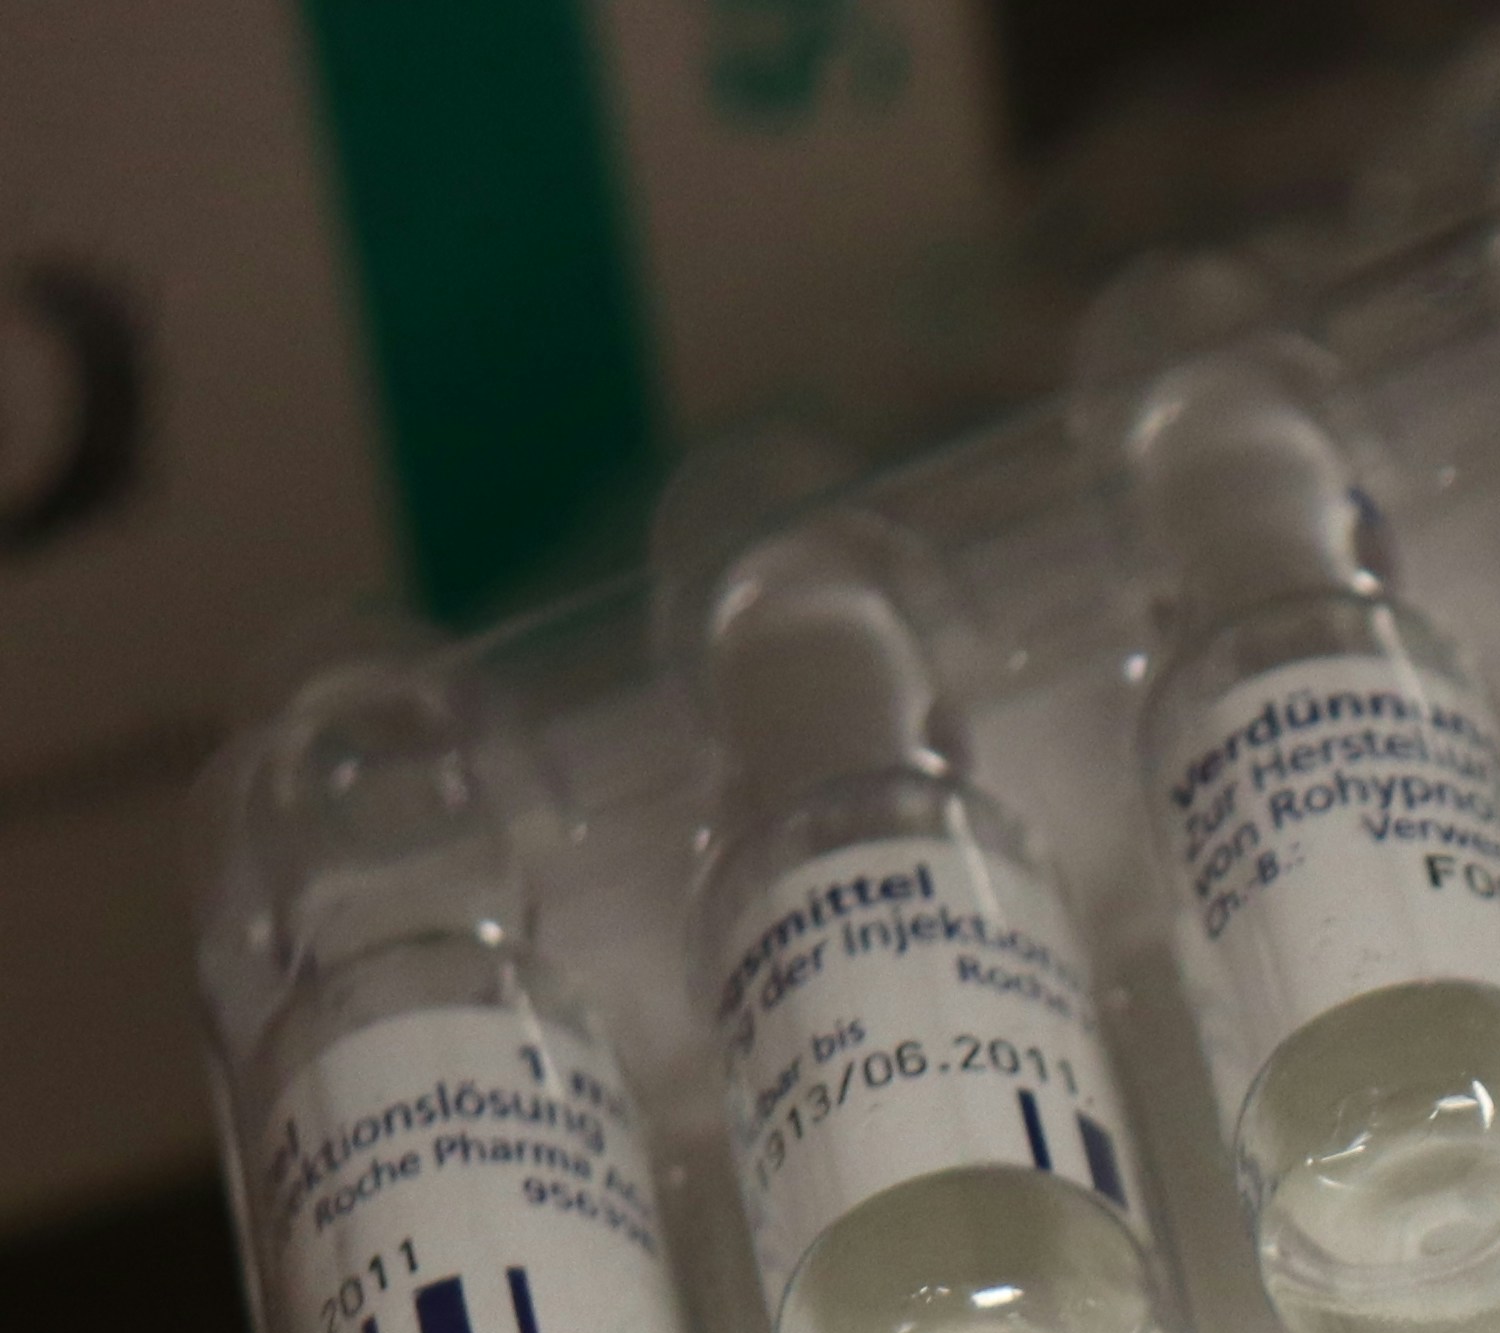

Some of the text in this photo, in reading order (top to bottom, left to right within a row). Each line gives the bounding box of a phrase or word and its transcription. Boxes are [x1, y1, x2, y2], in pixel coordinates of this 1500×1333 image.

[1187, 782, 1240, 863] Zur
[1195, 821, 1260, 898] von
[761, 939, 829, 1009] der
[812, 1016, 866, 1065] bis
[313, 1147, 422, 1231] Roche
[434, 1131, 592, 1180] Pharma
